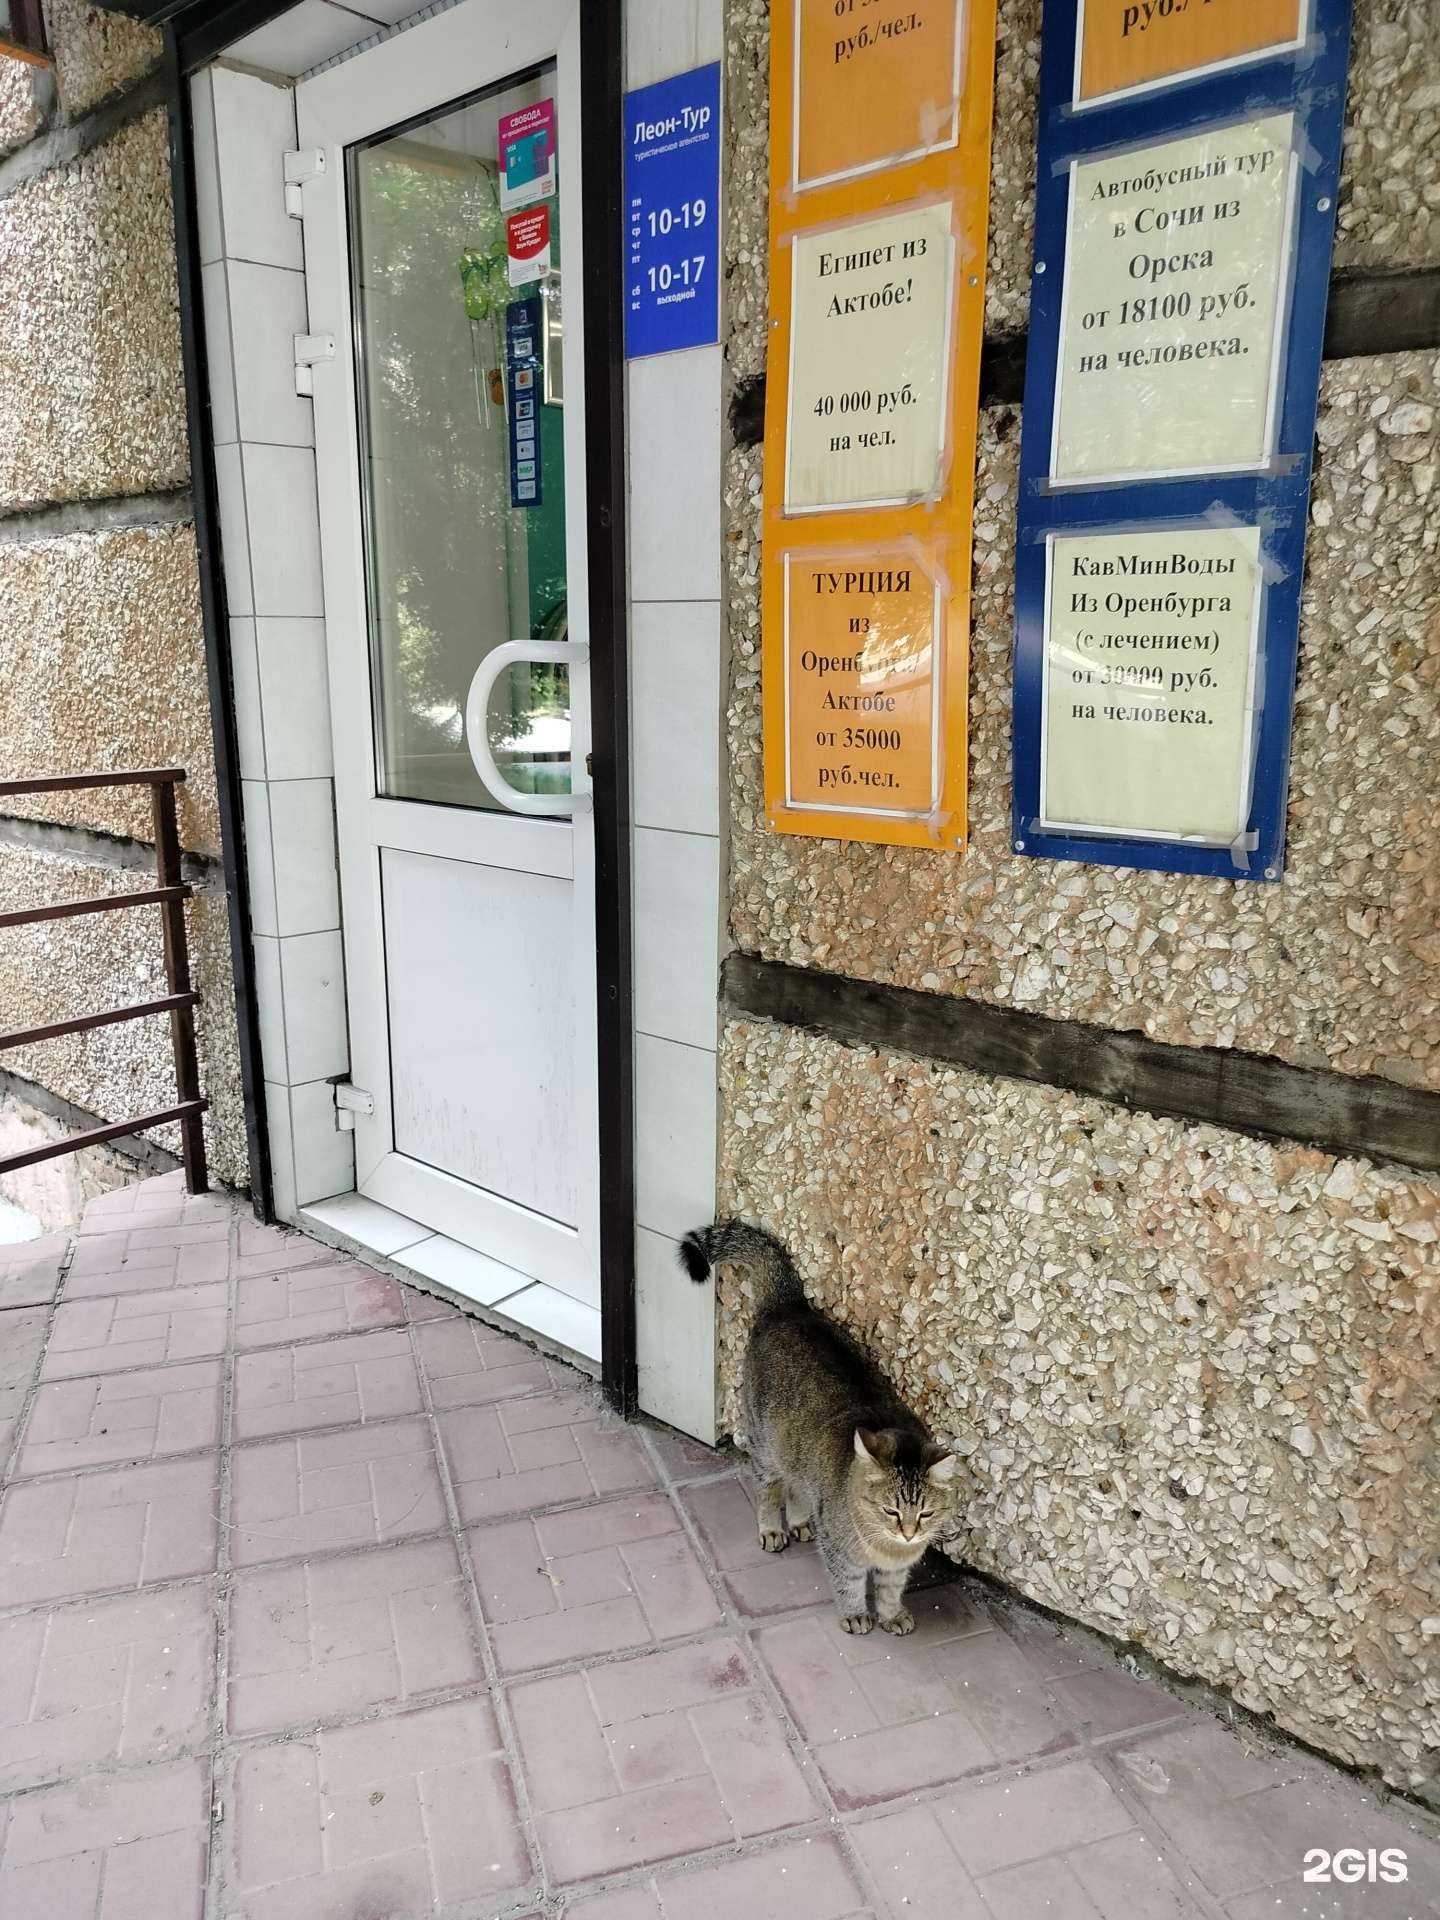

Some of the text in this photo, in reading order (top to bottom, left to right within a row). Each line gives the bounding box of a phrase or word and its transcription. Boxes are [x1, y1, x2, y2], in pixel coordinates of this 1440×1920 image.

[835, 14, 922, 64] руб./чел.
[510, 109, 541, 128] СВОБОДА
[634, 106, 711, 145] Леон-Тур
[635, 133, 710, 162] туристическое агентство
[1090, 149, 1274, 201] Автобусный тур
[632, 198, 642, 208] пн
[632, 213, 641, 222] вт
[648, 199, 706, 237] 10-19
[1113, 199, 1241, 239] в Сочи из
[632, 227, 641, 237] ср
[632, 241, 641, 250] чт
[818, 237, 927, 278] Египет из
[632, 256, 641, 264] пт
[1128, 248, 1214, 283] Орска
[648, 256, 705, 292] 10-17
[632, 285, 641, 296] сб
[657, 288, 696, 305] выходной
[826, 278, 913, 318] Актобе!
[632, 302, 641, 310] вс
[1082, 283, 1256, 330] от 18100 руб.
[1079, 336, 1249, 374] на человека.
[813, 383, 917, 418] 40 000 руб.
[829, 428, 896, 452] на чел.
[1071, 553, 1236, 577] КавМинВоды
[812, 570, 911, 598] ТУРЦИЯ
[1069, 591, 1232, 617] Из Оренбурга
[848, 616, 870, 634] из
[1075, 628, 1219, 655] (с лечением)
[1071, 669, 1095, 685] от
[1170, 667, 1218, 693] руб.
[821, 690, 896, 713] Актобе
[1071, 703, 1214, 725] на человека.
[816, 727, 901, 752] от 35000
[818, 764, 901, 789] руб.чел.
